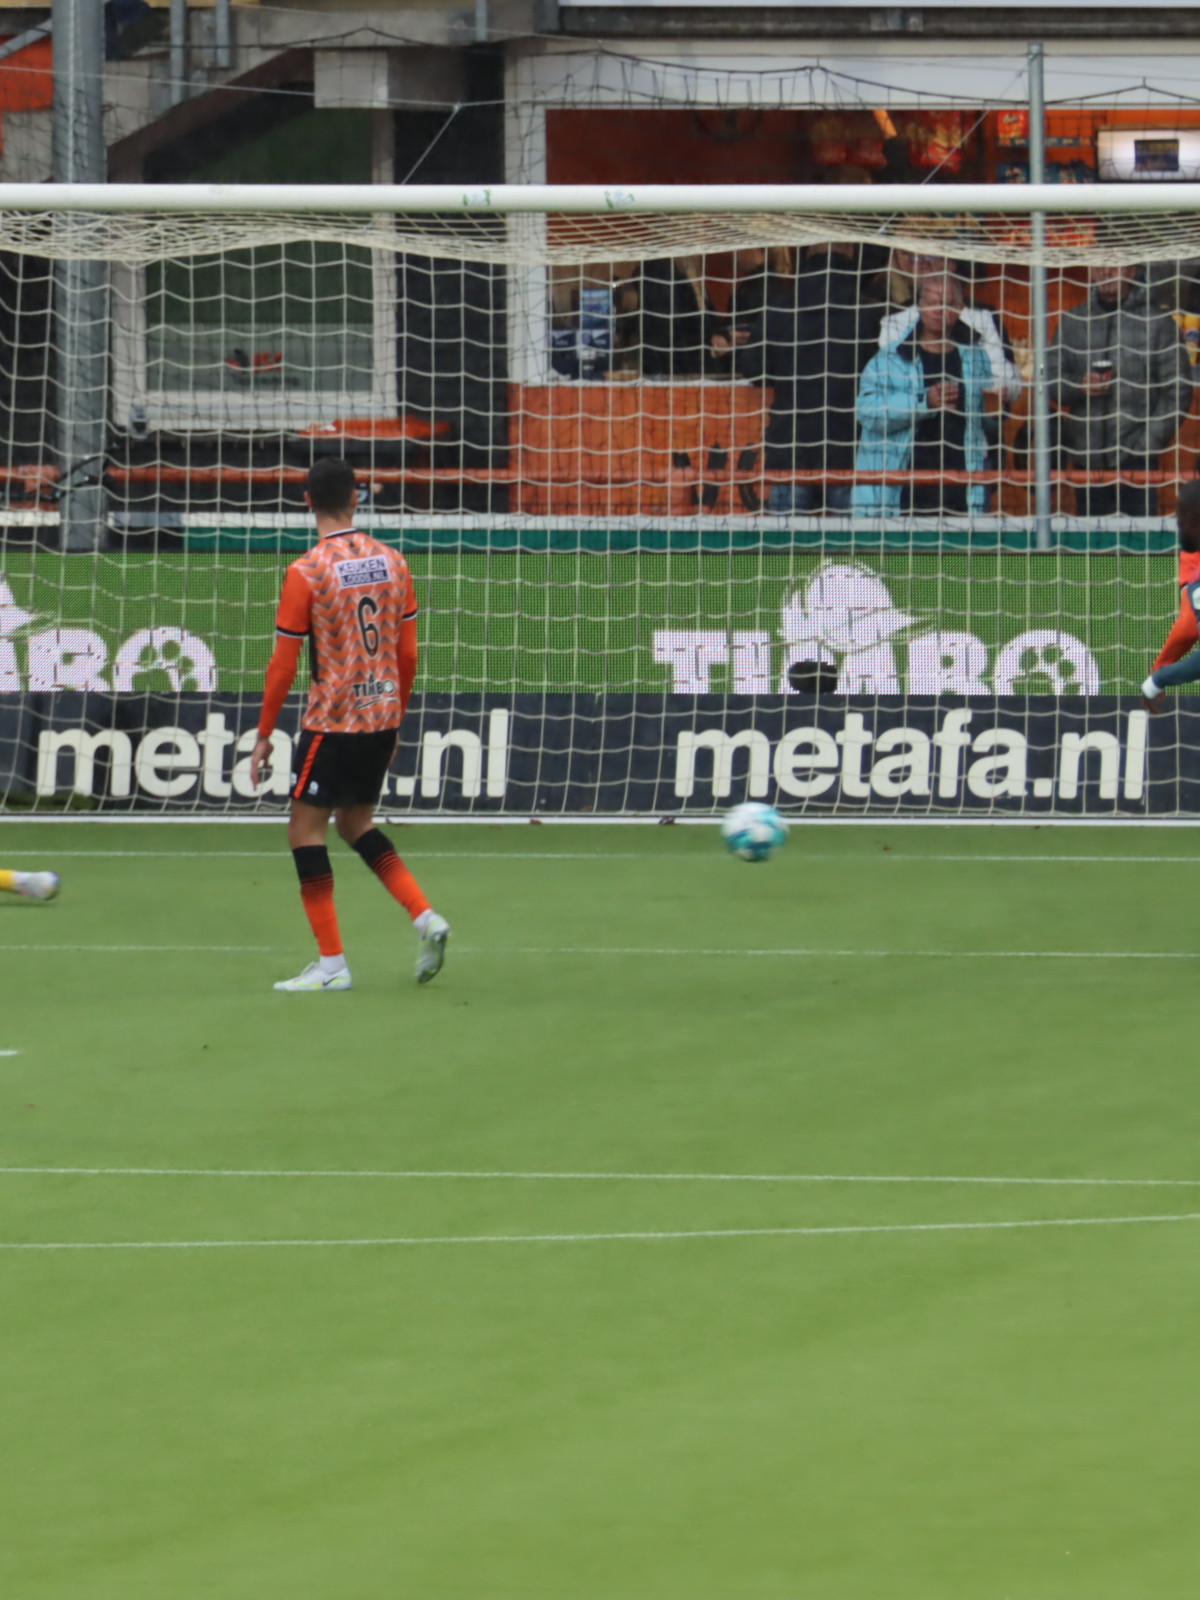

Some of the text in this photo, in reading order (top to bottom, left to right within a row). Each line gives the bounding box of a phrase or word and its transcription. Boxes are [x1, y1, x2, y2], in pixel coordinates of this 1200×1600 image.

[357, 595, 379, 657] 6
[37, 708, 509, 798] meta.nl
[674, 708, 1149, 800] metafa.nl
